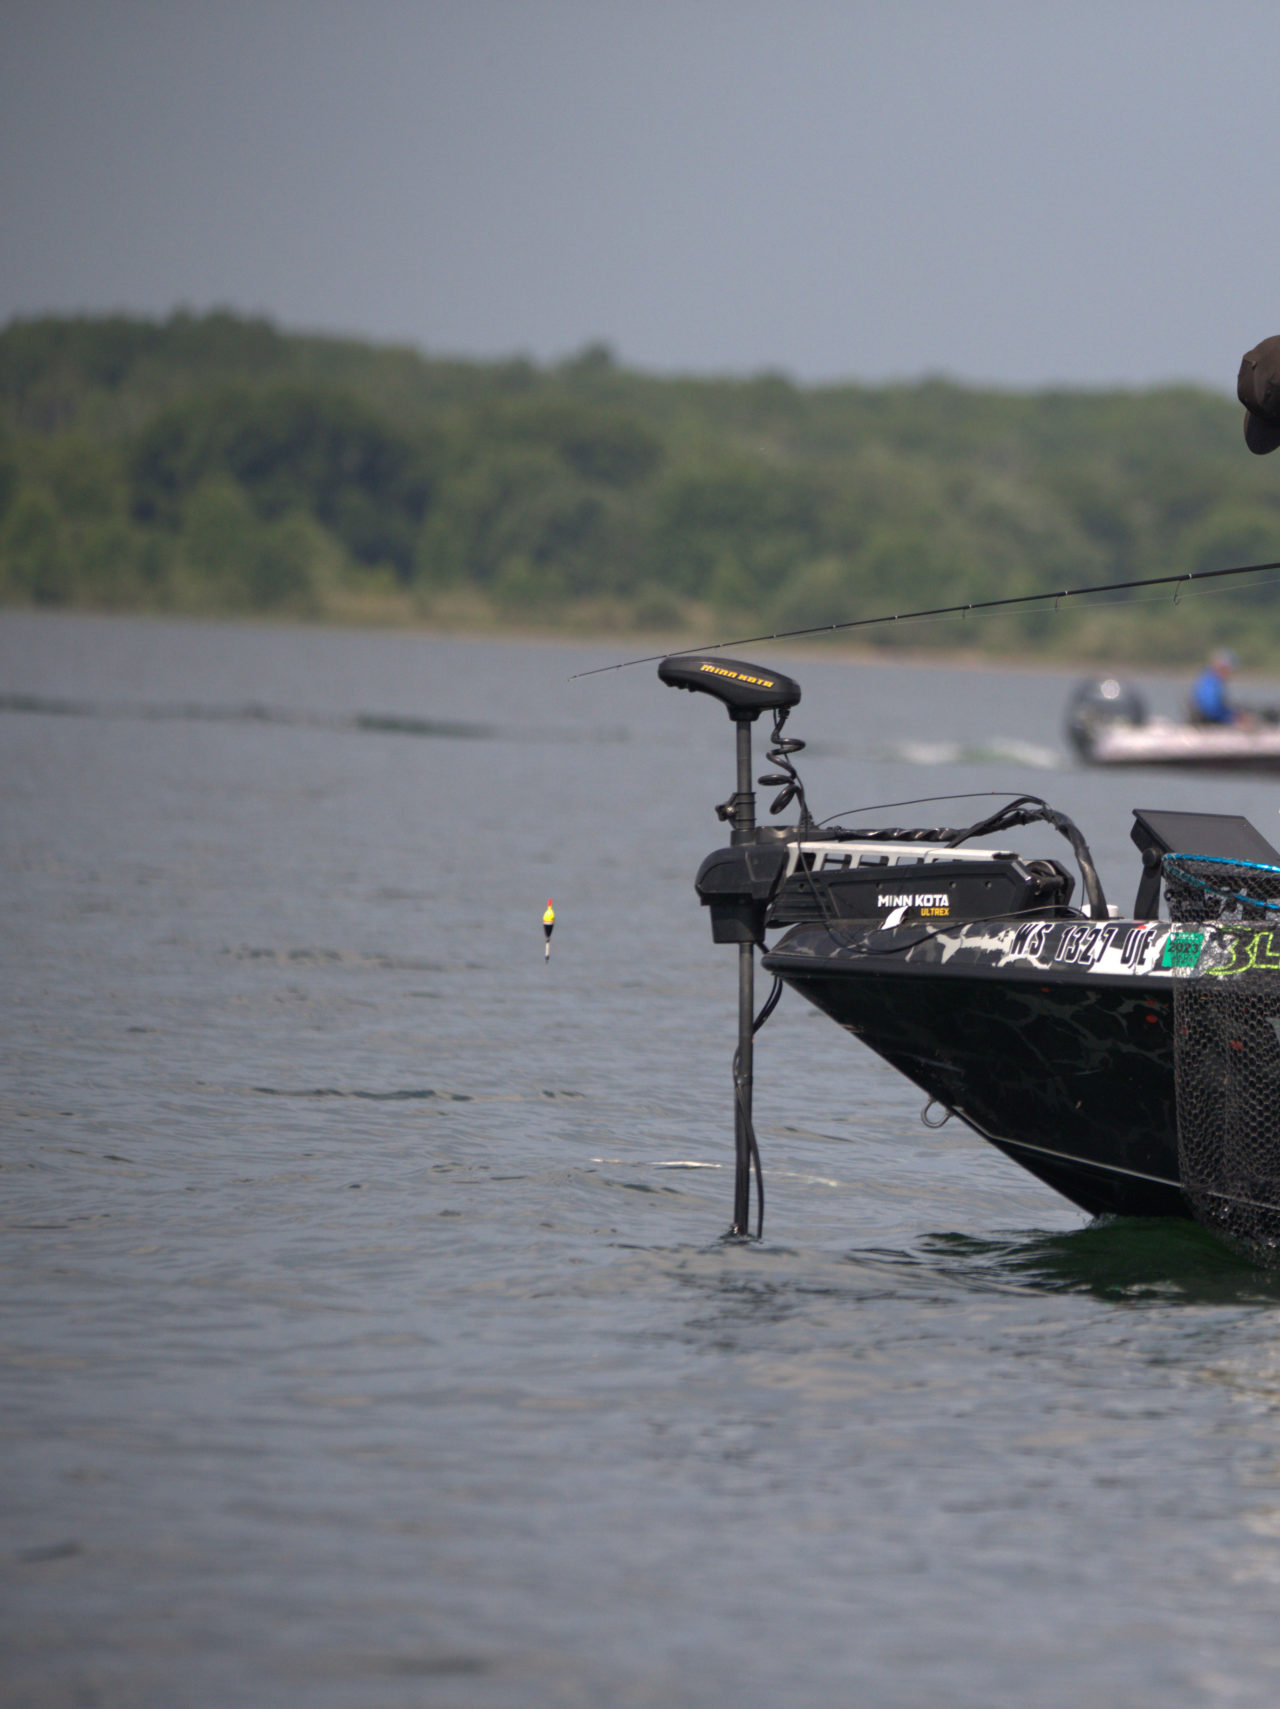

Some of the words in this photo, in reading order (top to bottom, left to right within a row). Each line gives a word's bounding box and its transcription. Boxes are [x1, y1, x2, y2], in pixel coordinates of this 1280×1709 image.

[877, 894, 913, 907] MINN
[914, 894, 949, 907] KOTA
[920, 907, 949, 917] ULTREX
[1010, 923, 1055, 957] WS
[1055, 926, 1118, 965] 1327
